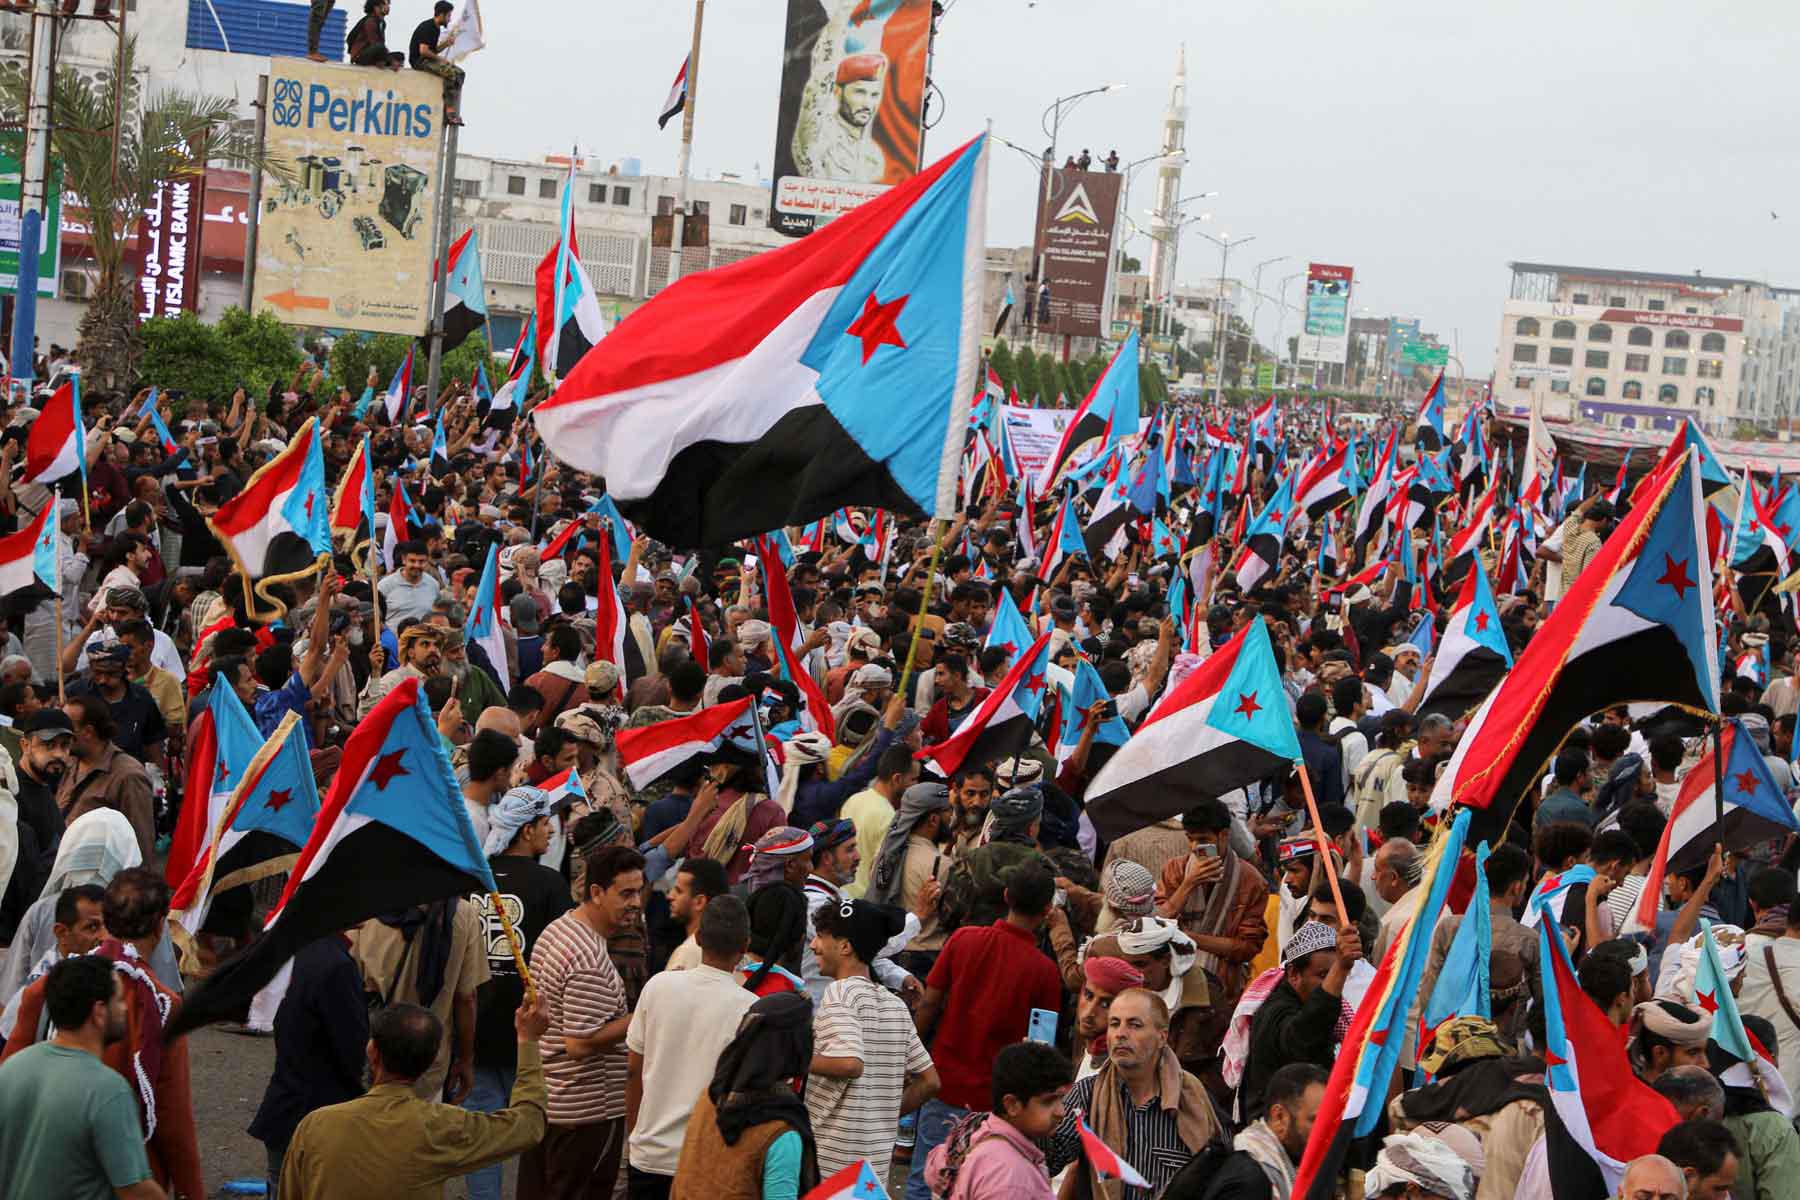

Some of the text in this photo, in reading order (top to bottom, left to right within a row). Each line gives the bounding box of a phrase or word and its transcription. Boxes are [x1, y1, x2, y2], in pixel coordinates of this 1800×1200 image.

[307, 83, 432, 138] Perkins
[170, 182, 191, 234] BANK
[164, 235, 187, 305] ISLAMIC
